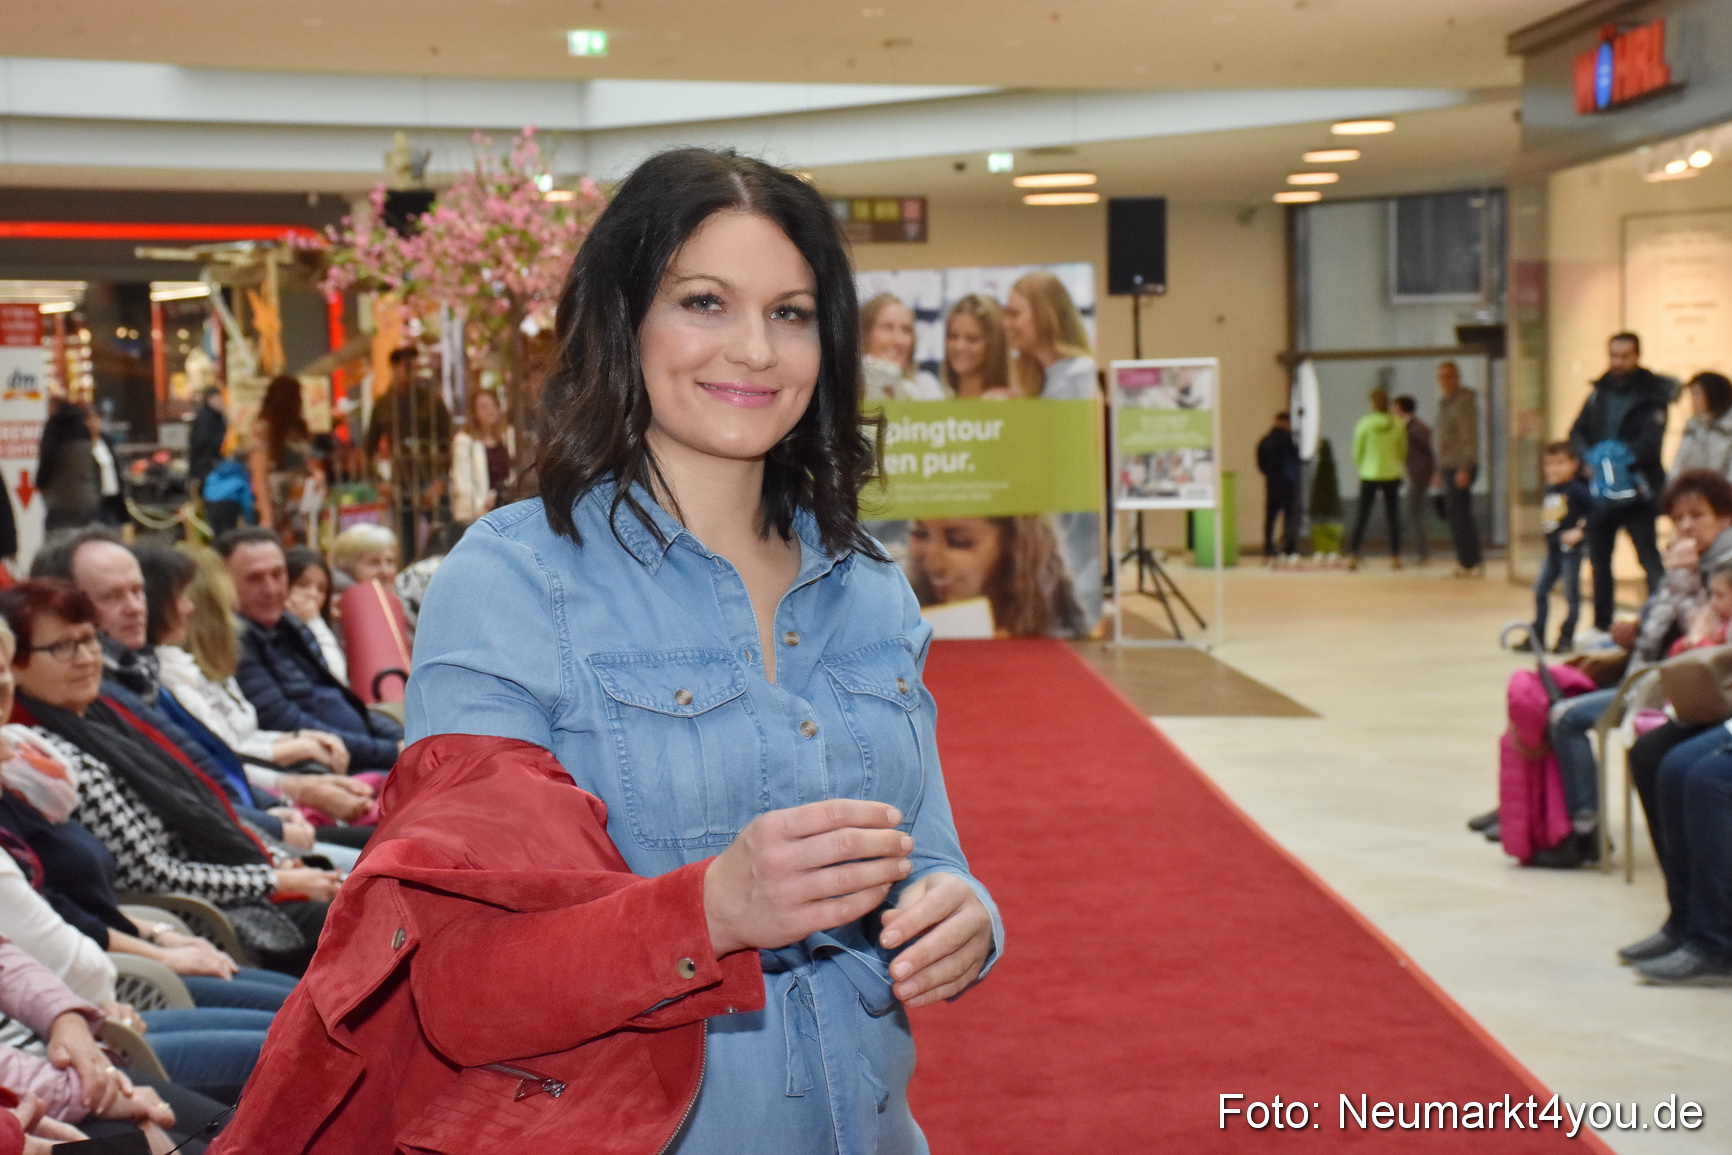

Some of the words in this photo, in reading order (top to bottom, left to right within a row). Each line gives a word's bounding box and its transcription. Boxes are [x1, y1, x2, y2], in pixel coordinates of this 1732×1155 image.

[882, 416, 1004, 448] pingtour
[881, 453, 918, 475] en
[922, 451, 976, 478] pur.
